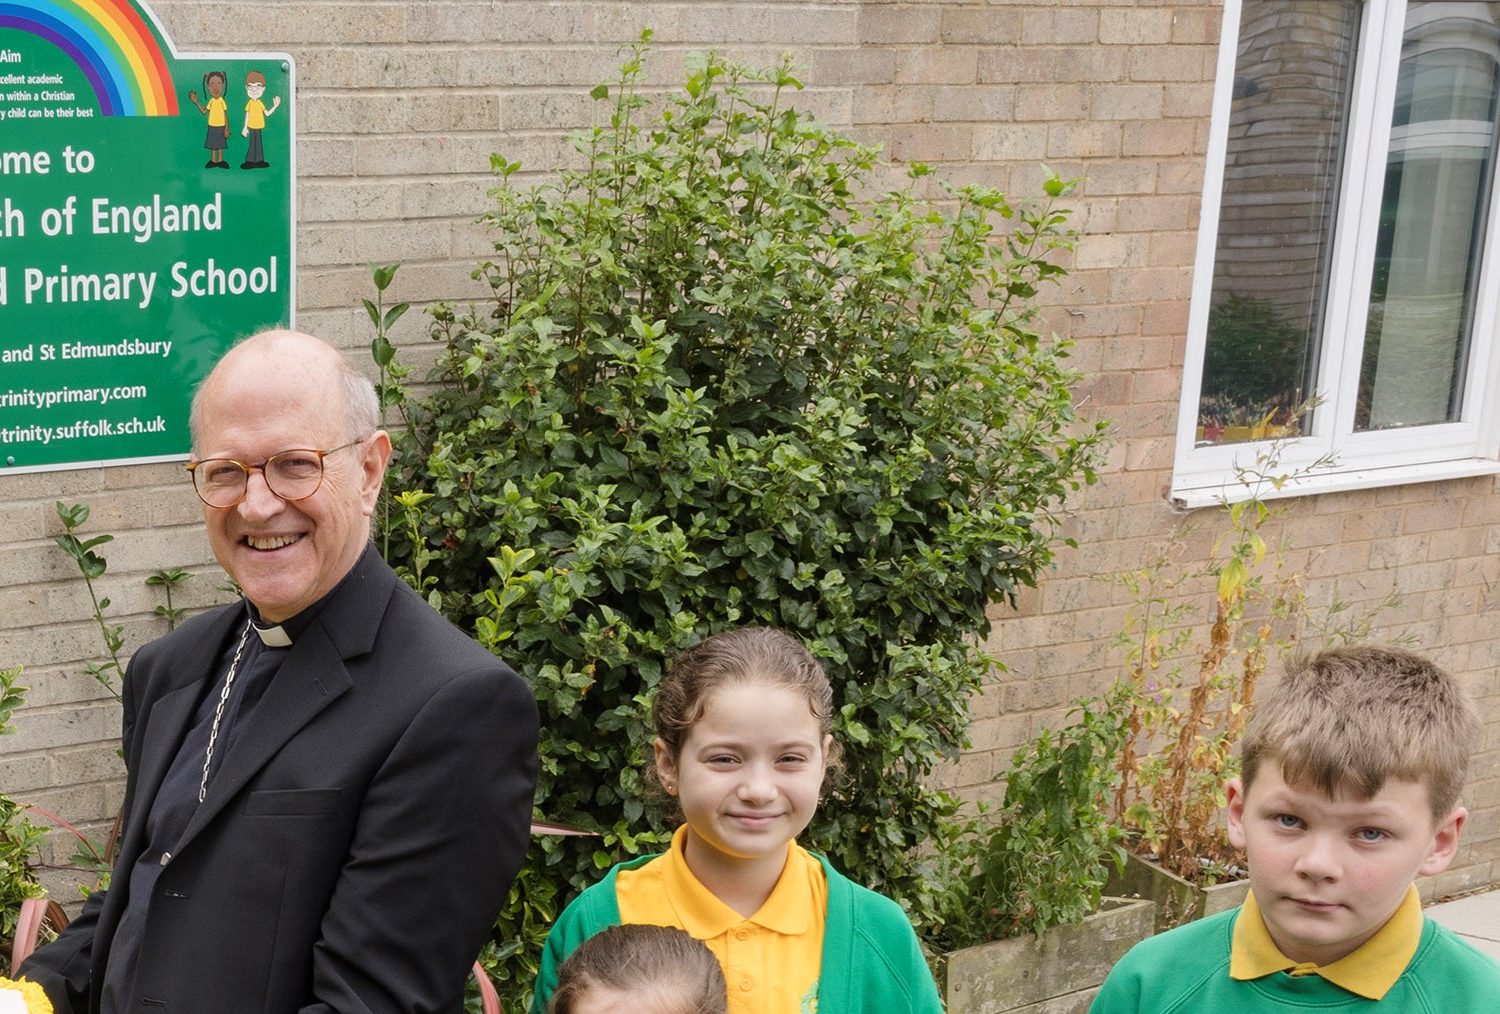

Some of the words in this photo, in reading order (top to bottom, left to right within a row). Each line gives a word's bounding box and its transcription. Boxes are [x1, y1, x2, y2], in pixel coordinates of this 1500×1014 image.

[0, 49, 21, 62] Aim
[27, 74, 63, 84] academic
[7, 91, 31, 101] within
[34, 93, 39, 101] a
[41, 91, 75, 101] Christian
[8, 108, 26, 118] child
[28, 110, 42, 118] can
[44, 108, 54, 117] be
[56, 107, 74, 117] their
[77, 107, 93, 117] best
[62, 145, 94, 173] to
[41, 196, 76, 236] of
[92, 192, 221, 243] England
[25, 265, 157, 308] Primary
[172, 256, 276, 297] School
[2, 344, 33, 362] and
[40, 344, 55, 360] St
[62, 338, 172, 359] Edmundsbury
